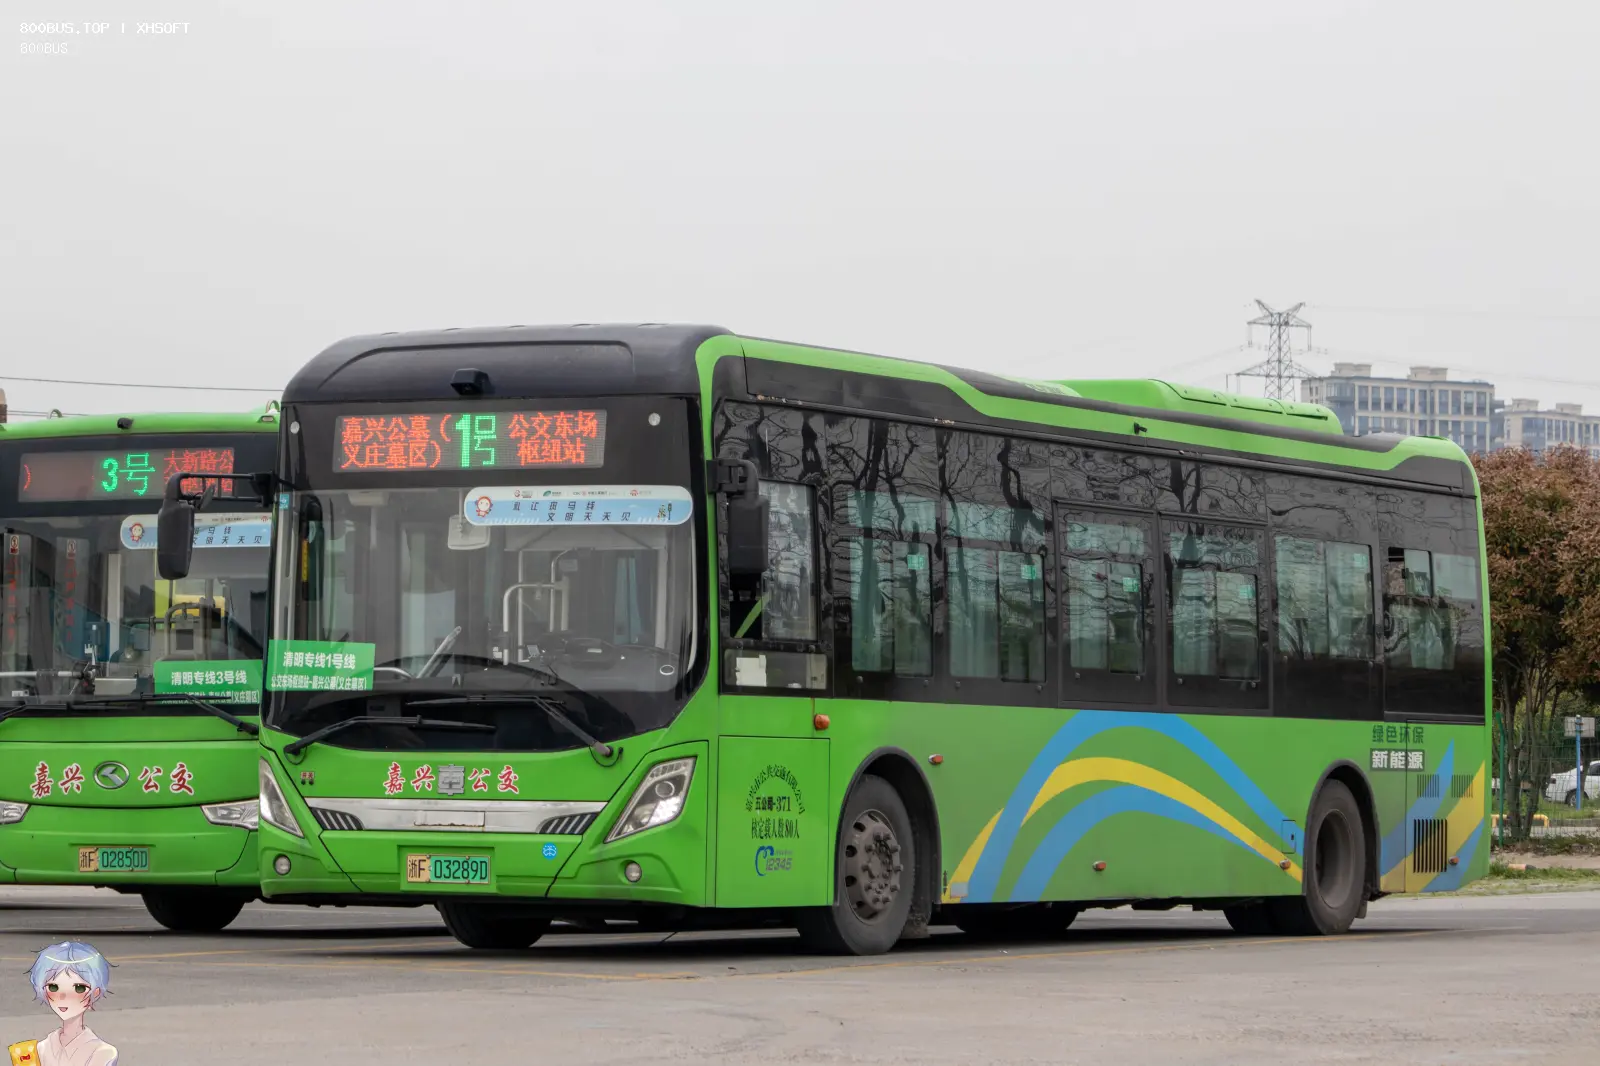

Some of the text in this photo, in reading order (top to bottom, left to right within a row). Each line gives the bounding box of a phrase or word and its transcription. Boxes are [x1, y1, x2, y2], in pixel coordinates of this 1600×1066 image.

[508, 411, 598, 440] 公交东场
[517, 438, 586, 466] 枢纽站
[102, 453, 155, 496] 3号
[283, 652, 356, 669] 清明专线1号线
[171, 670, 248, 685] 清明专线3号线
[1372, 724, 1424, 744] 绿色环保
[1371, 750, 1424, 769] 新能源
